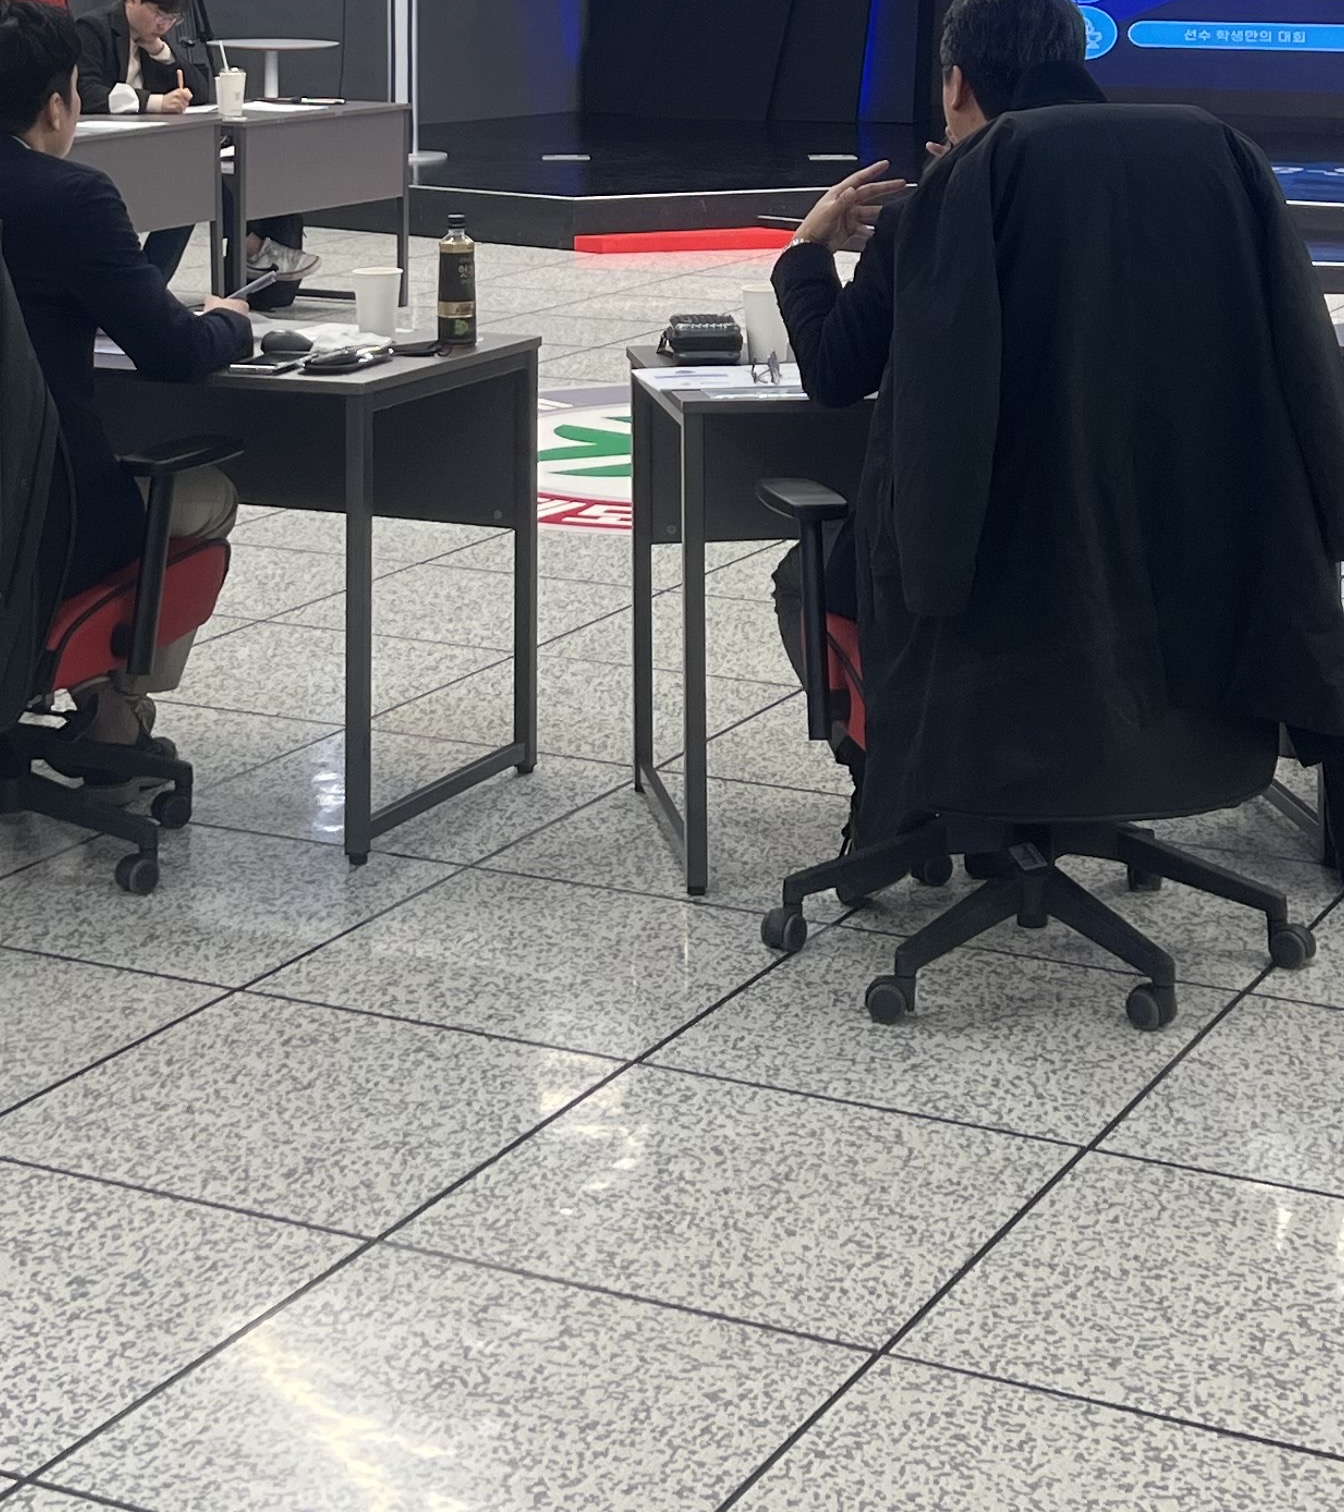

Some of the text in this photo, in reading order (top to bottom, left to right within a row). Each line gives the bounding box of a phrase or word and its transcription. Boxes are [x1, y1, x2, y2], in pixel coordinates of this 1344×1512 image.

[1184, 29, 1306, 44] 선수 학생만의 대회
